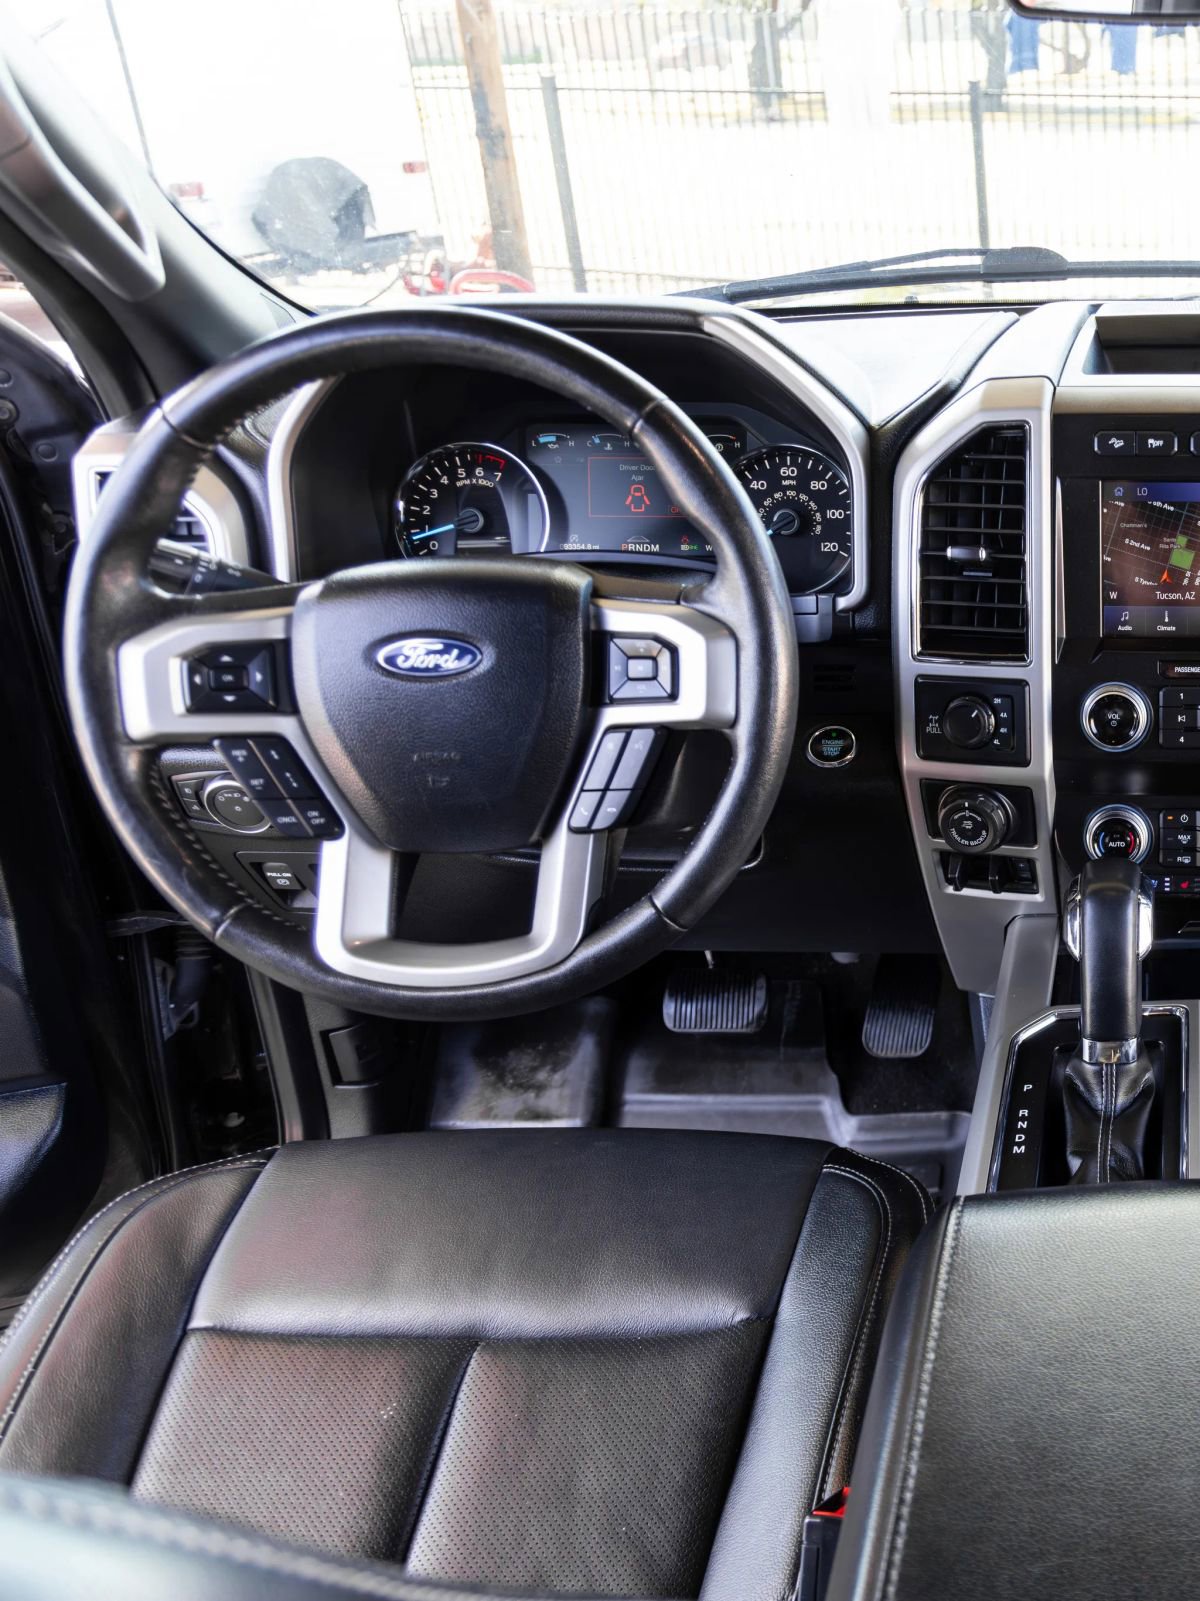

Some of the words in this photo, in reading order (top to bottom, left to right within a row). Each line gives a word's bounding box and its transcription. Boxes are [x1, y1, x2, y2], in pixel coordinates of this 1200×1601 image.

[458, 468, 466, 478] 5
[475, 467, 484, 476] 6
[780, 467, 797, 476] 60
[440, 475, 448, 485] 4
[494, 472, 502, 482] 7
[456, 479, 470, 487] RPM
[478, 478, 494, 487] 1000
[750, 480, 767, 490] 40
[810, 480, 827, 490] 80
[430, 489, 438, 498] 3
[1137, 487, 1148, 496] LO
[423, 506, 431, 514] 2
[827, 509, 844, 519] 100
[430, 541, 438, 550] 0
[821, 542, 838, 552] 120
[1109, 591, 1118, 599] W
[1155, 591, 1184, 601] Tucson,
[1184, 591, 1196, 600] AZ
[396, 643, 473, 671] Ford
[926, 726, 942, 734] PULL
[310, 817, 325, 825] OFF
[1023, 1084, 1033, 1092] P
[1018, 1109, 1029, 1117] R
[1017, 1121, 1028, 1129] N
[1014, 1134, 1026, 1142] D
[1012, 1146, 1026, 1154] M
